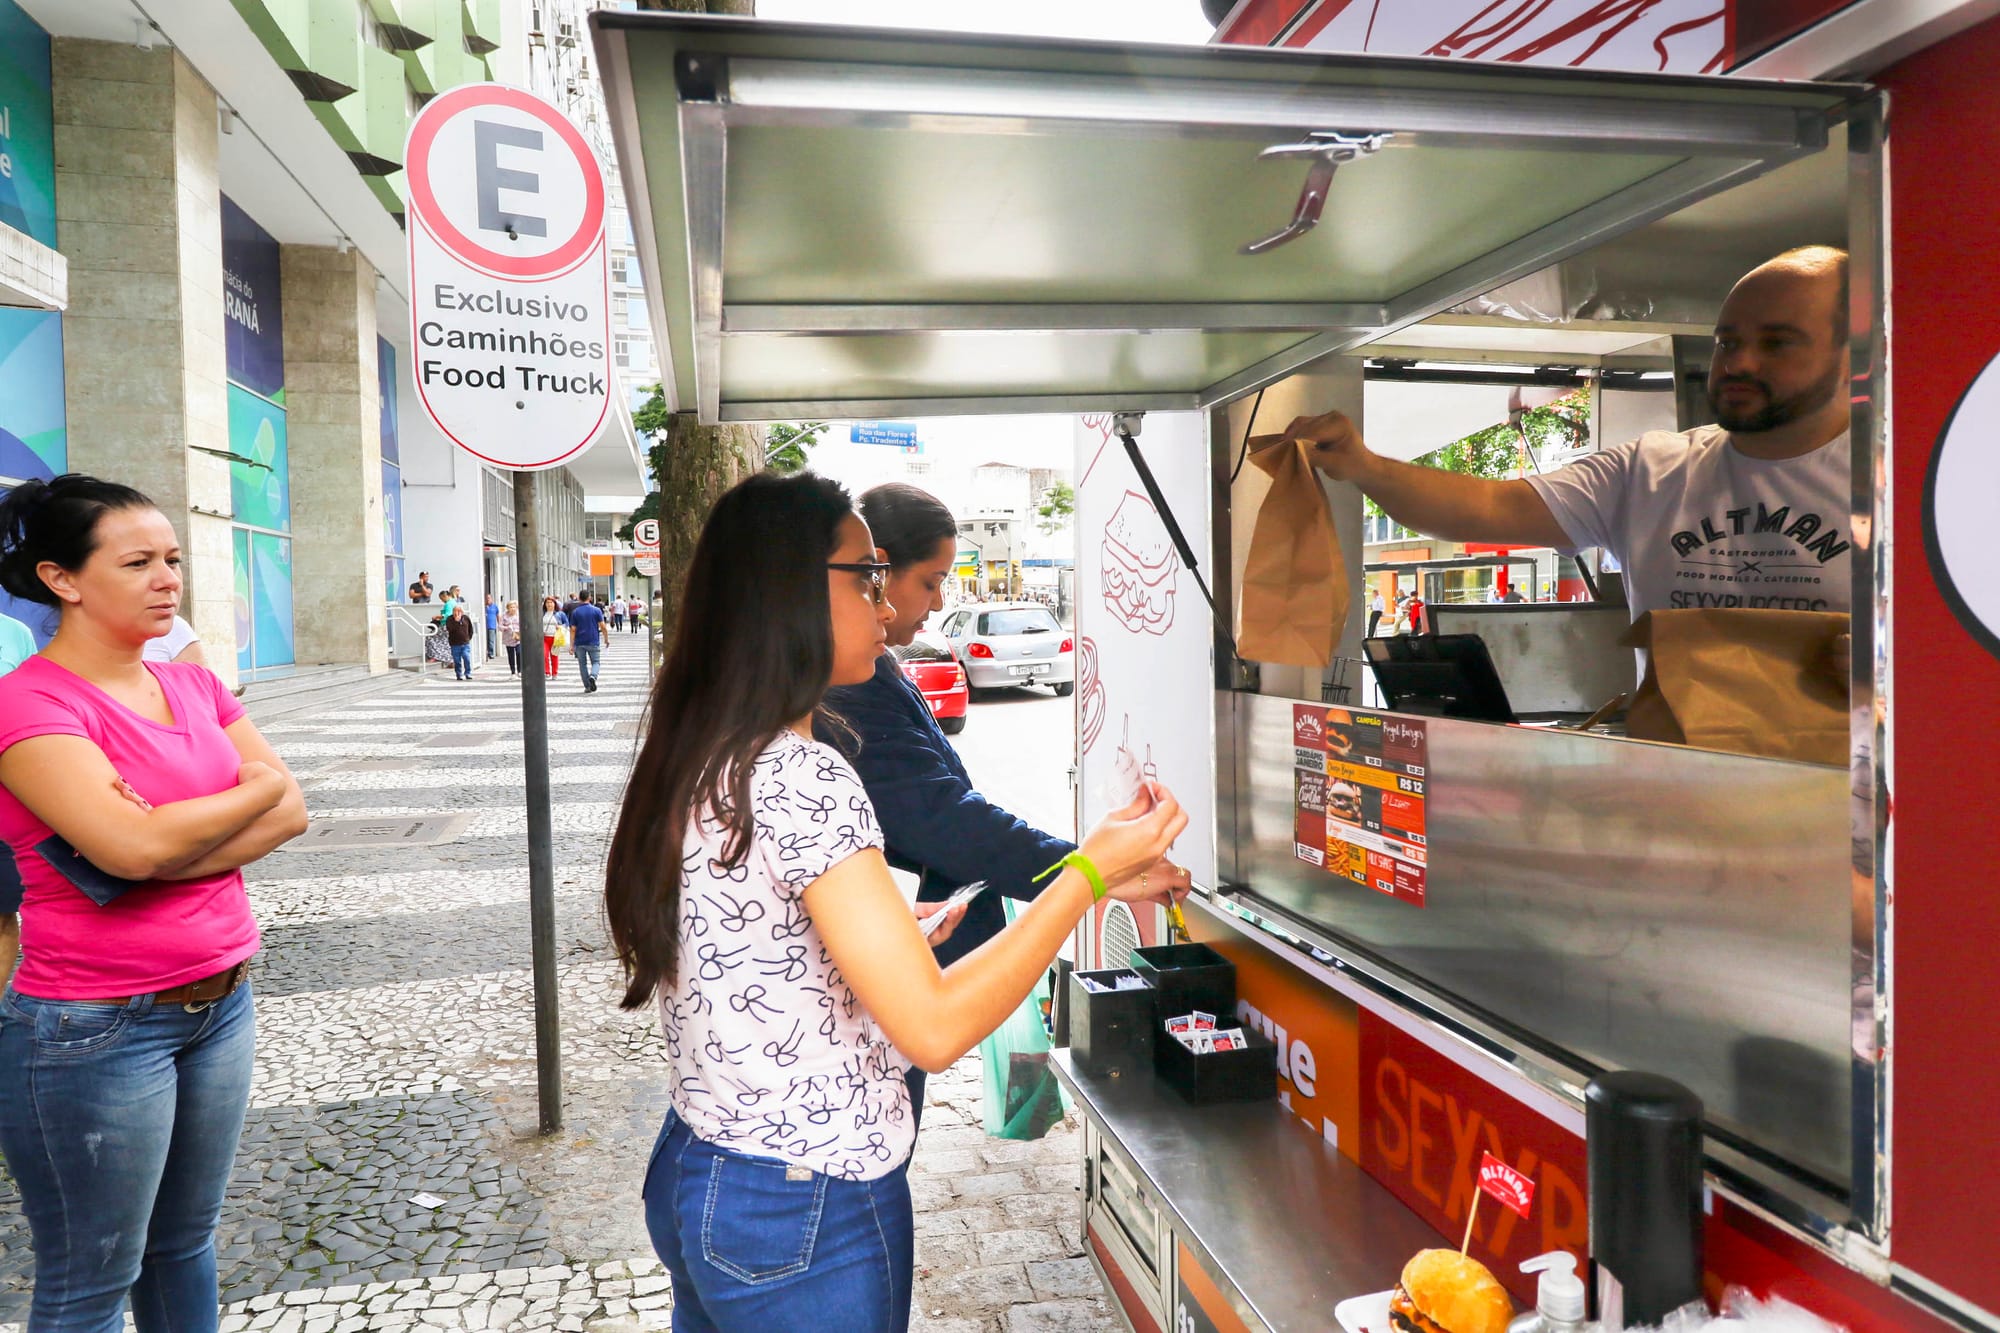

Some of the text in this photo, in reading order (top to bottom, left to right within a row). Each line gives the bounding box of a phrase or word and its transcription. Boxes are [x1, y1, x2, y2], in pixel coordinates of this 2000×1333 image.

[474, 120, 547, 237] E
[224, 290, 260, 335] RANÁ
[435, 284, 588, 322] Exclusivo
[420, 321, 604, 360] Caminhões
[423, 360, 605, 396] Food Truck
[644, 524, 655, 540] E
[1671, 502, 1850, 564] ALTMAN
[1709, 548, 1797, 557] GASTRONOMIA
[1676, 571, 1706, 580] FOOD
[1709, 573, 1750, 583] MOBILE
[1764, 575, 1821, 585] CATERING
[1295, 714, 1322, 735] ALTMAN
[1295, 757, 1324, 771] JANEIRO
[1413, 780, 1422, 793] 12
[1481, 1165, 1529, 1205] ALTMAN
